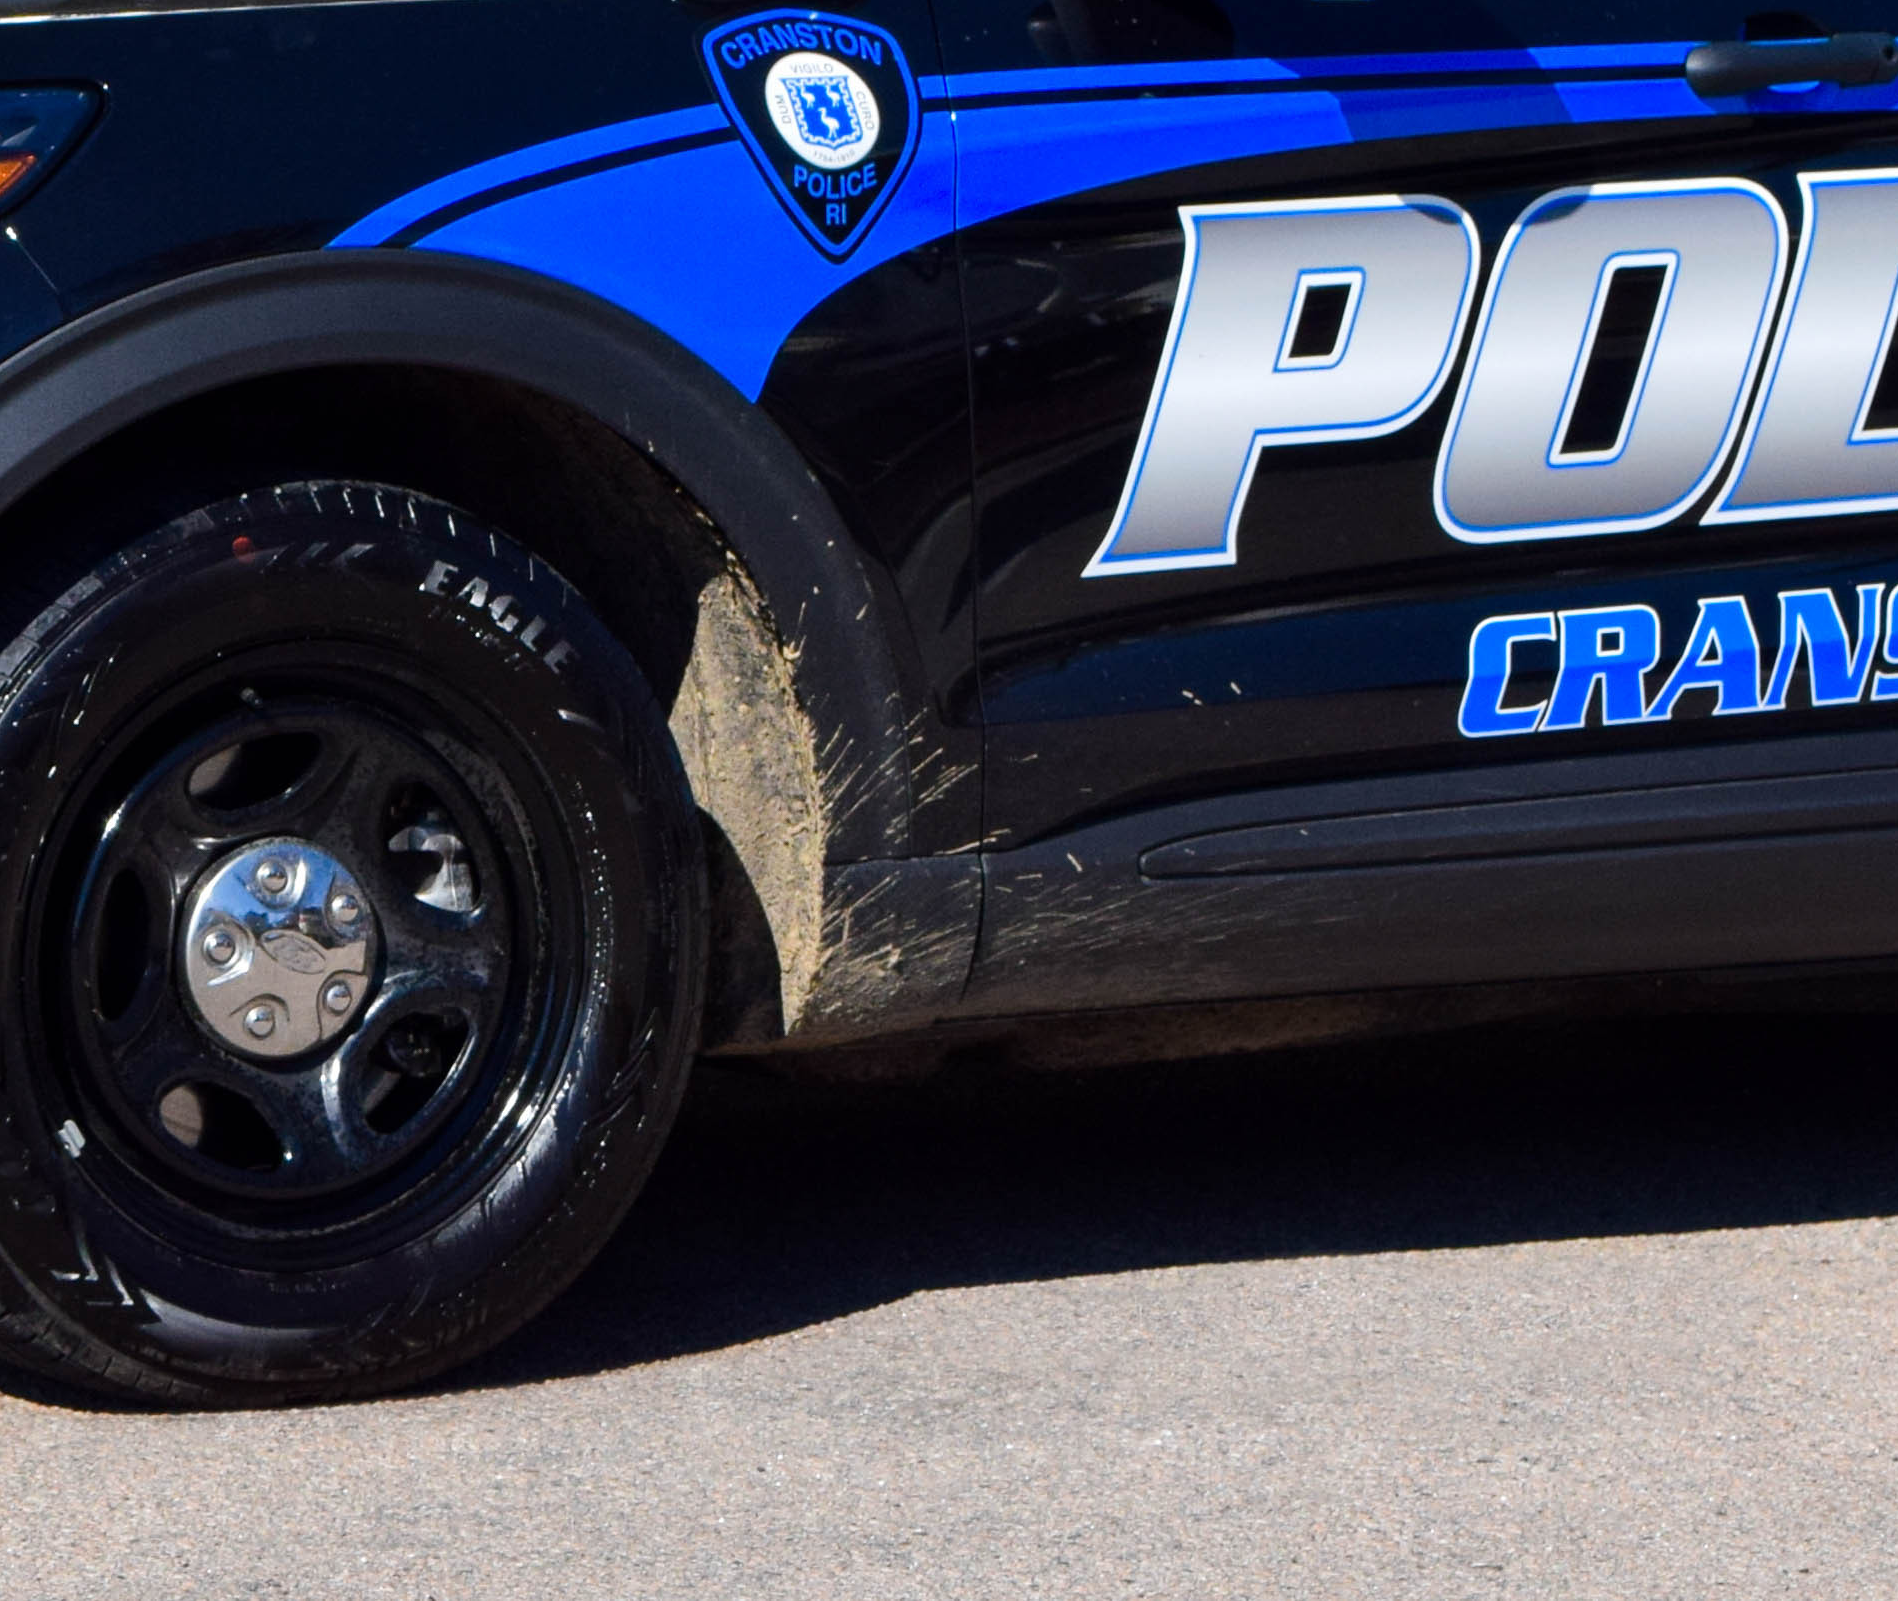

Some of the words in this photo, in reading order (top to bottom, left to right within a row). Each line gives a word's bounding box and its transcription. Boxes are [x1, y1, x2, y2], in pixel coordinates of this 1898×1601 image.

[720, 22, 882, 70] CRANSTON
[775, 95, 792, 125] DUM
[789, 62, 835, 75] VIGILO
[855, 90, 876, 131] CURO
[793, 163, 878, 200] POLICE
[825, 202, 848, 227] RI
[418, 559, 581, 675] EAGLE
